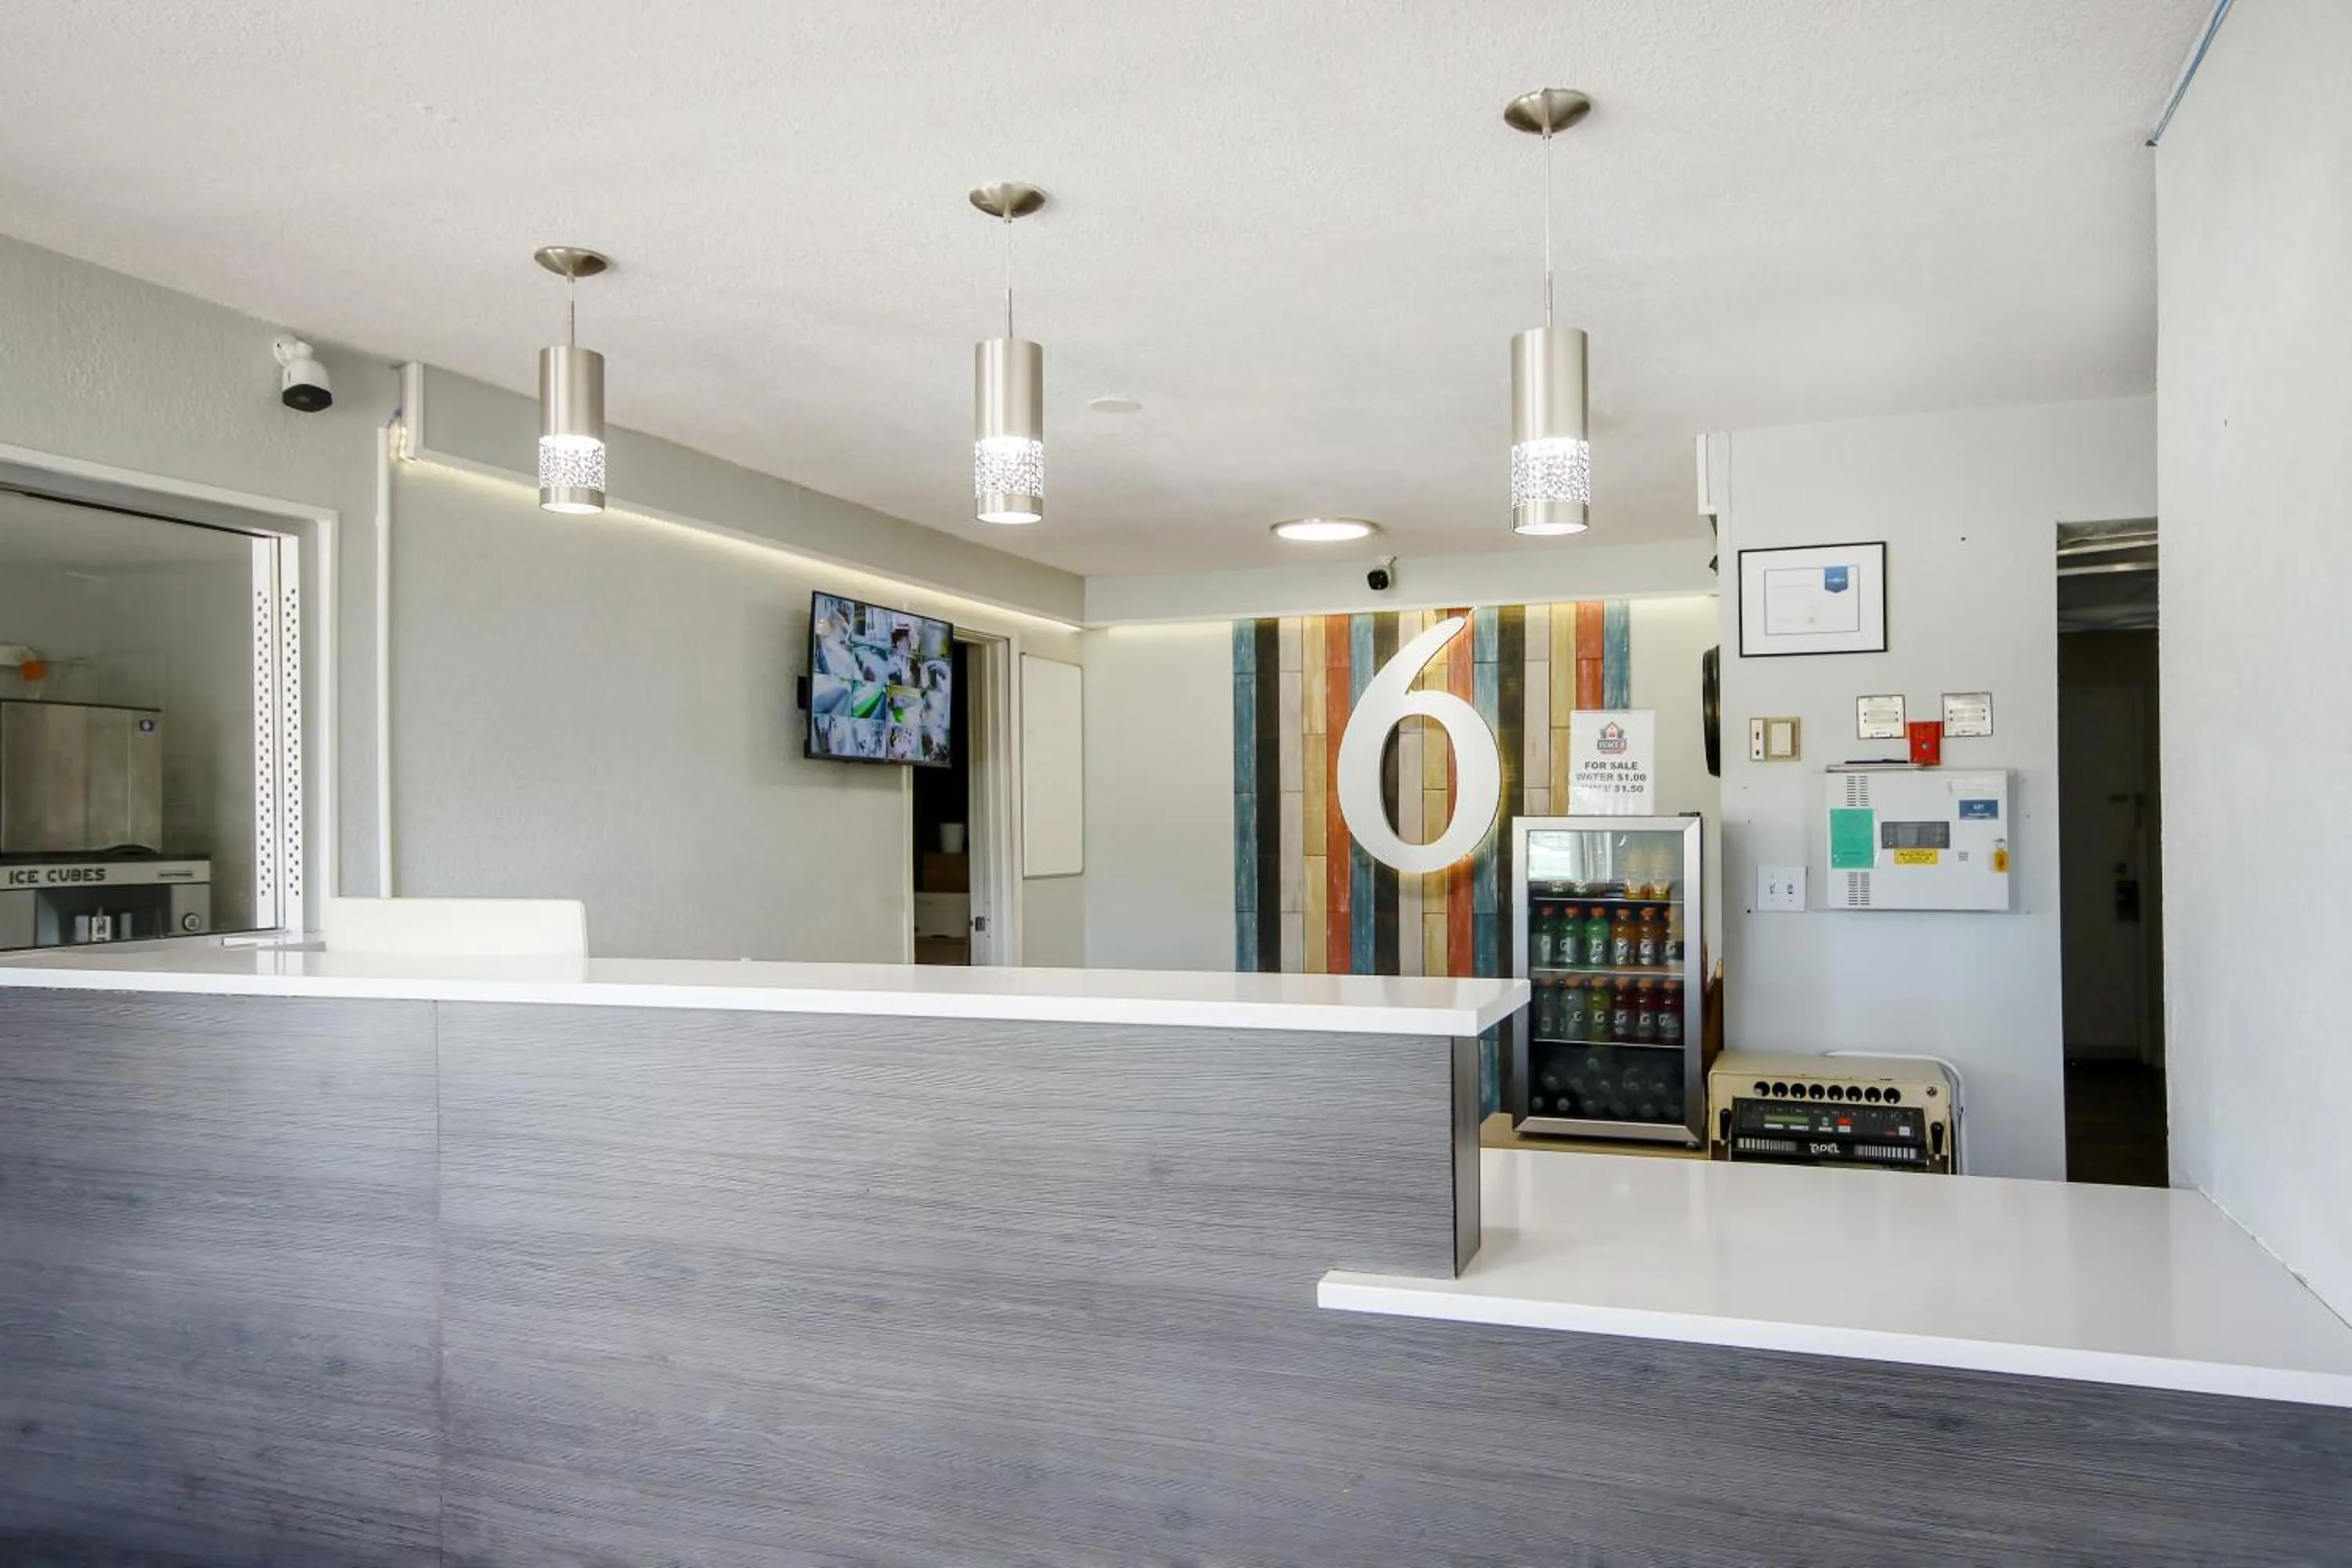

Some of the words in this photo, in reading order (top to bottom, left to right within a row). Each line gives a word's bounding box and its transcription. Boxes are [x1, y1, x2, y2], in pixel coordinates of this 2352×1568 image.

[1337, 615, 1501, 873] 6
[1584, 761, 1606, 770] FOR
[1610, 761, 1638, 770] SALE
[1575, 772, 1613, 782] WATER
[1617, 773, 1646, 782] $1.00
[9, 869, 39, 885] ICE
[46, 868, 107, 884] CUBES
